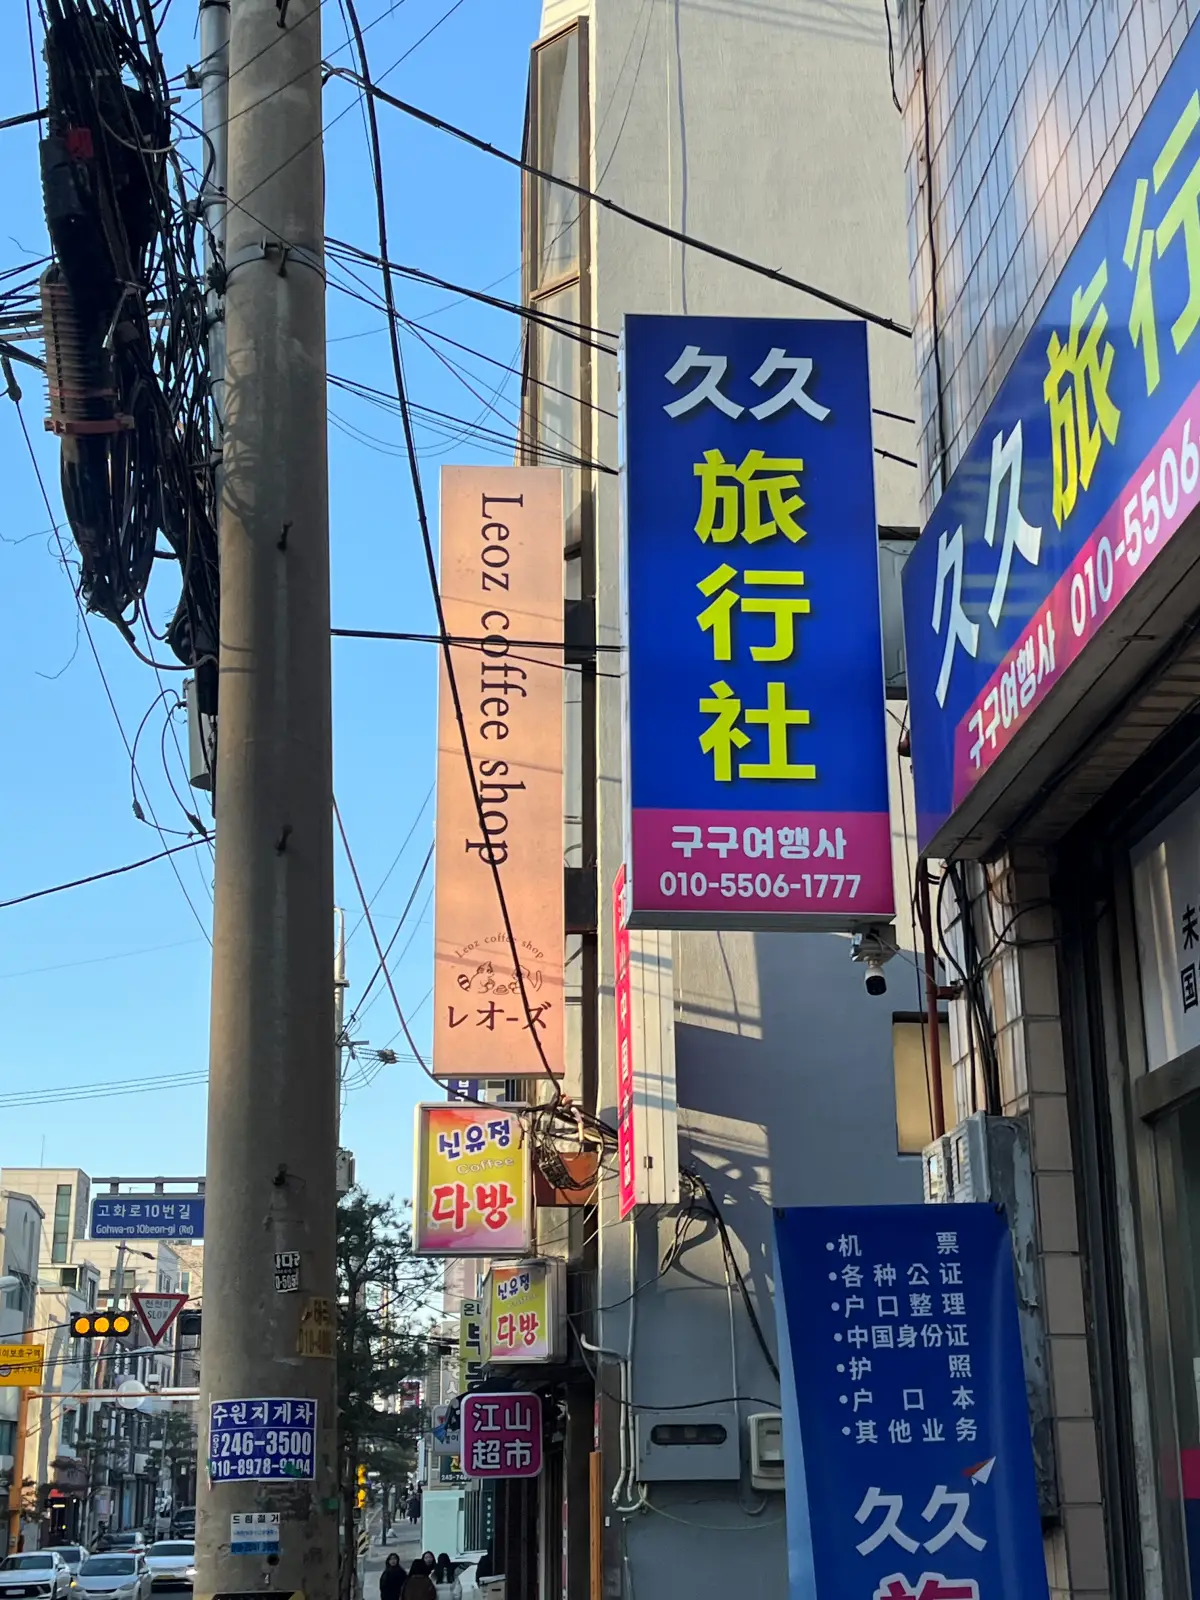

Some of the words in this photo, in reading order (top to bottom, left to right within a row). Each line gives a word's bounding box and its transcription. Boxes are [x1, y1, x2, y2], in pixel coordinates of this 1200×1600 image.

[663, 345, 831, 422] 久久
[480, 493, 524, 591] Leoz
[693, 448, 816, 783] 旅行社
[480, 610, 528, 741] coffee
[968, 610, 1056, 769] 구구여행사
[465, 760, 527, 867] shop
[671, 825, 847, 861] 구구여행사
[659, 872, 861, 899] 010-5506-1777
[455, 940, 481, 959] Leoz
[521, 940, 545, 959] shop
[447, 1000, 552, 1031] レオーズ
[438, 1118, 511, 1160] 신유정
[456, 1157, 515, 1176] Coffee
[97, 1203, 191, 1220] 고화로10번길
[431, 1183, 515, 1230] 다방
[95, 1224, 135, 1235] Gohwa-ro
[497, 1272, 530, 1301] 신유정
[841, 1262, 963, 1288] 各种公证
[147, 1310, 169, 1320] SLOW
[844, 1292, 966, 1318] 户口整理
[497, 1312, 539, 1346] 다방
[847, 1324, 969, 1350] 中国身份证
[0, 1348, 41, 1360] 이보호구역
[853, 1386, 975, 1412] 户口本
[212, 1401, 313, 1427] 수원지게차
[472, 1401, 532, 1431] 江山
[220, 1431, 312, 1457] 246-3500
[855, 1418, 978, 1444] 其他业务
[472, 1439, 532, 1470] 超市
[854, 1485, 987, 1556] 久久
